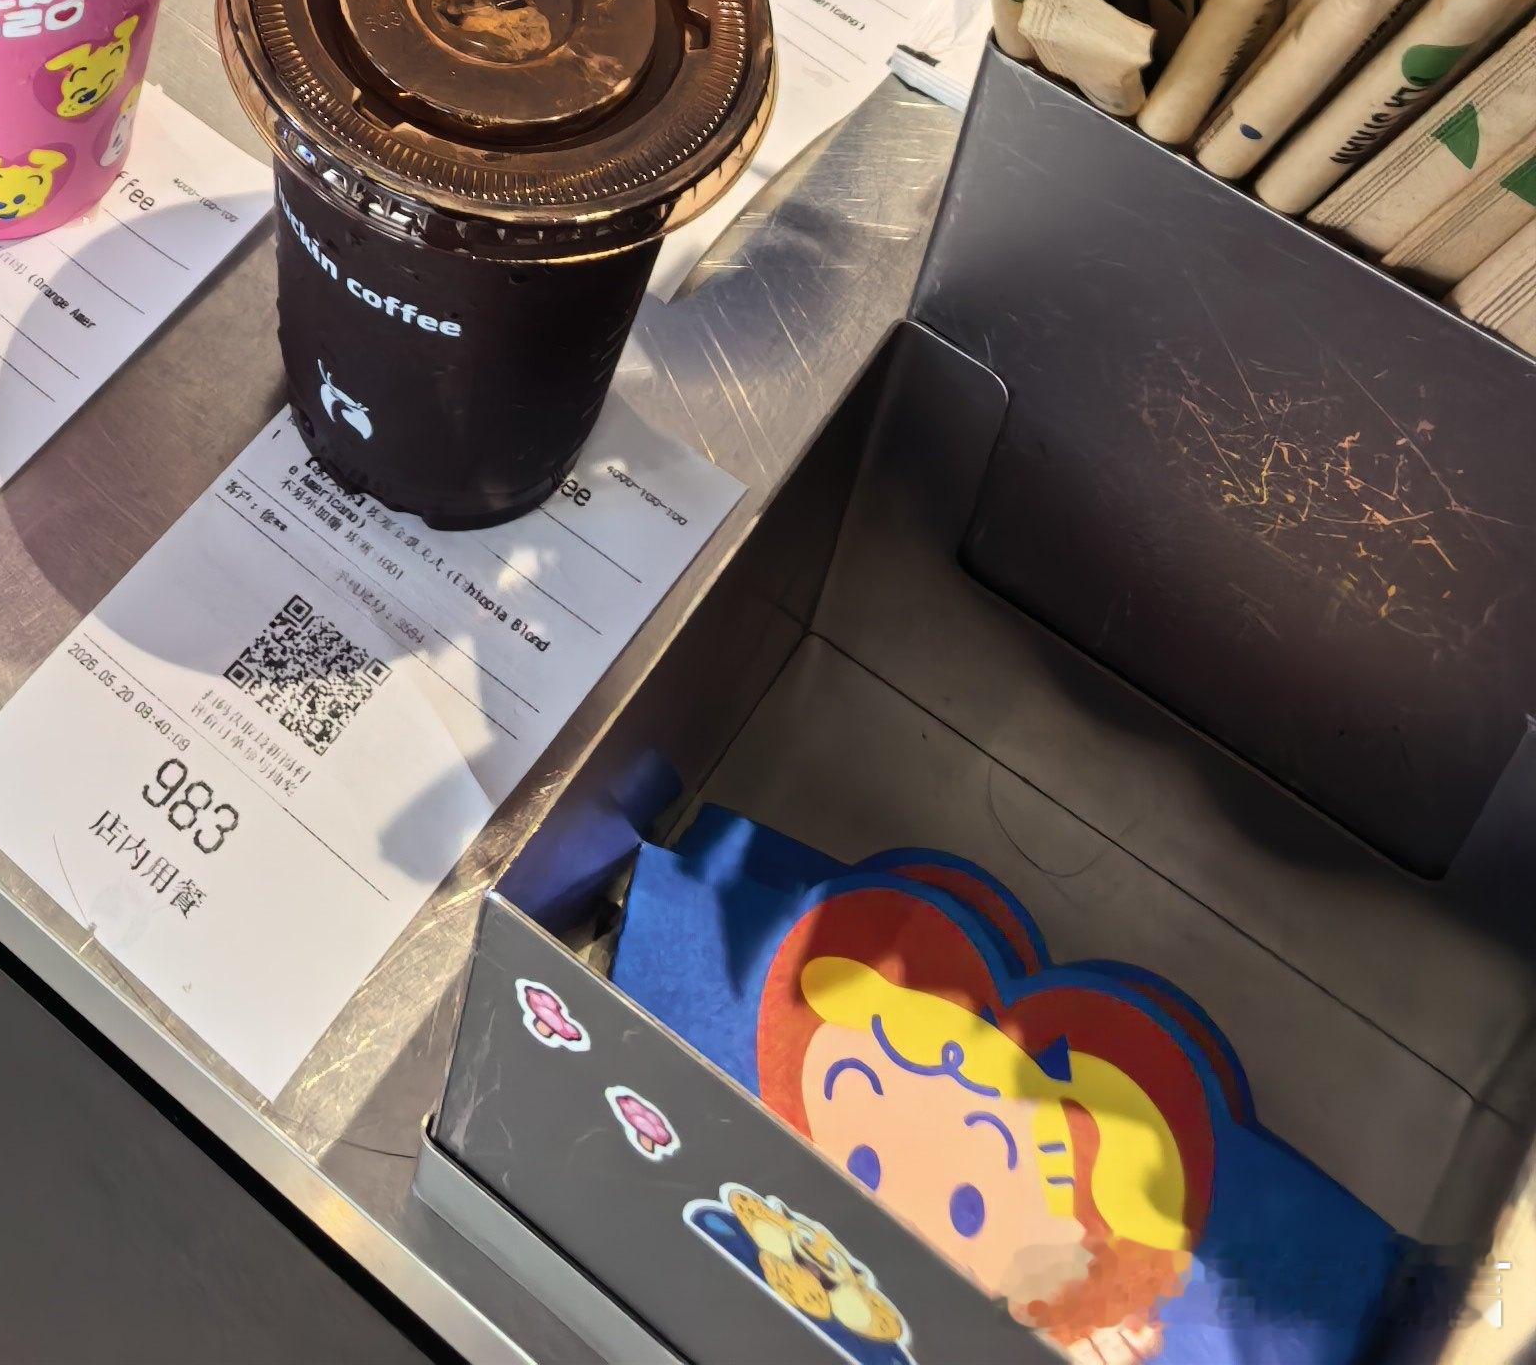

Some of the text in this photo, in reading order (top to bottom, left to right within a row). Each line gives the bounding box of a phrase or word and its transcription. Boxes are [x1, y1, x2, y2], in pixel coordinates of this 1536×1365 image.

[276, 178, 463, 338] luckin coffee
[297, 472, 369, 530] Americano)
[508, 616, 551, 653] Blond
[65, 640, 191, 753] 2026.05.20 08:40:09
[134, 752, 248, 859] 983
[87, 814, 209, 919] 店内用餐
